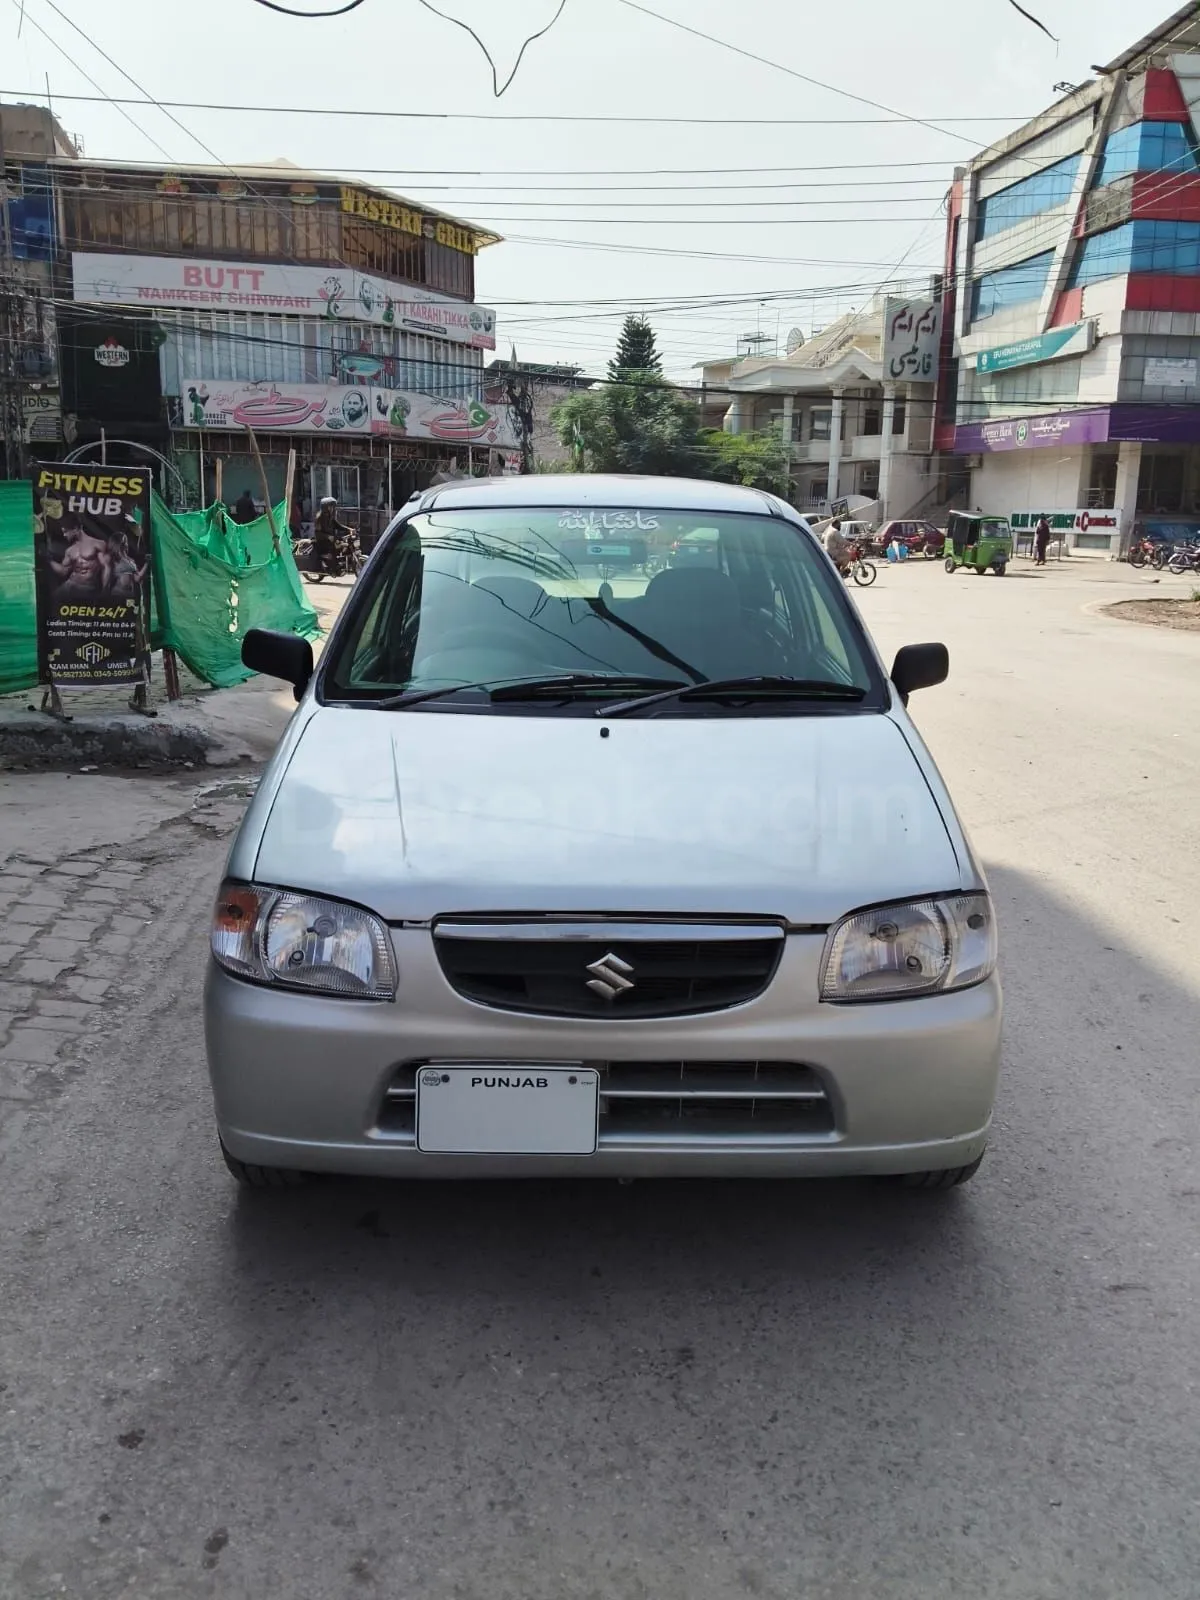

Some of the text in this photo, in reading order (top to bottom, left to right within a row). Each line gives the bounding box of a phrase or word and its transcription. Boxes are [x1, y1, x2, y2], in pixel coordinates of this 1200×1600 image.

[341, 186, 478, 256] WESTERN GRILL
[183, 265, 264, 291] BUTT
[138, 287, 311, 309] NAMKEEN SHINWARI
[409, 303, 441, 325] KARAHI
[443, 311, 469, 330] TIKKA
[96, 350, 128, 361] WESTERN
[38, 470, 142, 496] FITNESS
[68, 496, 122, 516] HUB
[60, 605, 127, 618] OPEN 24/7
[46, 619, 67, 628] Ladies
[68, 619, 92, 628] Timing:
[471, 1077, 549, 1088] PUNJAB
